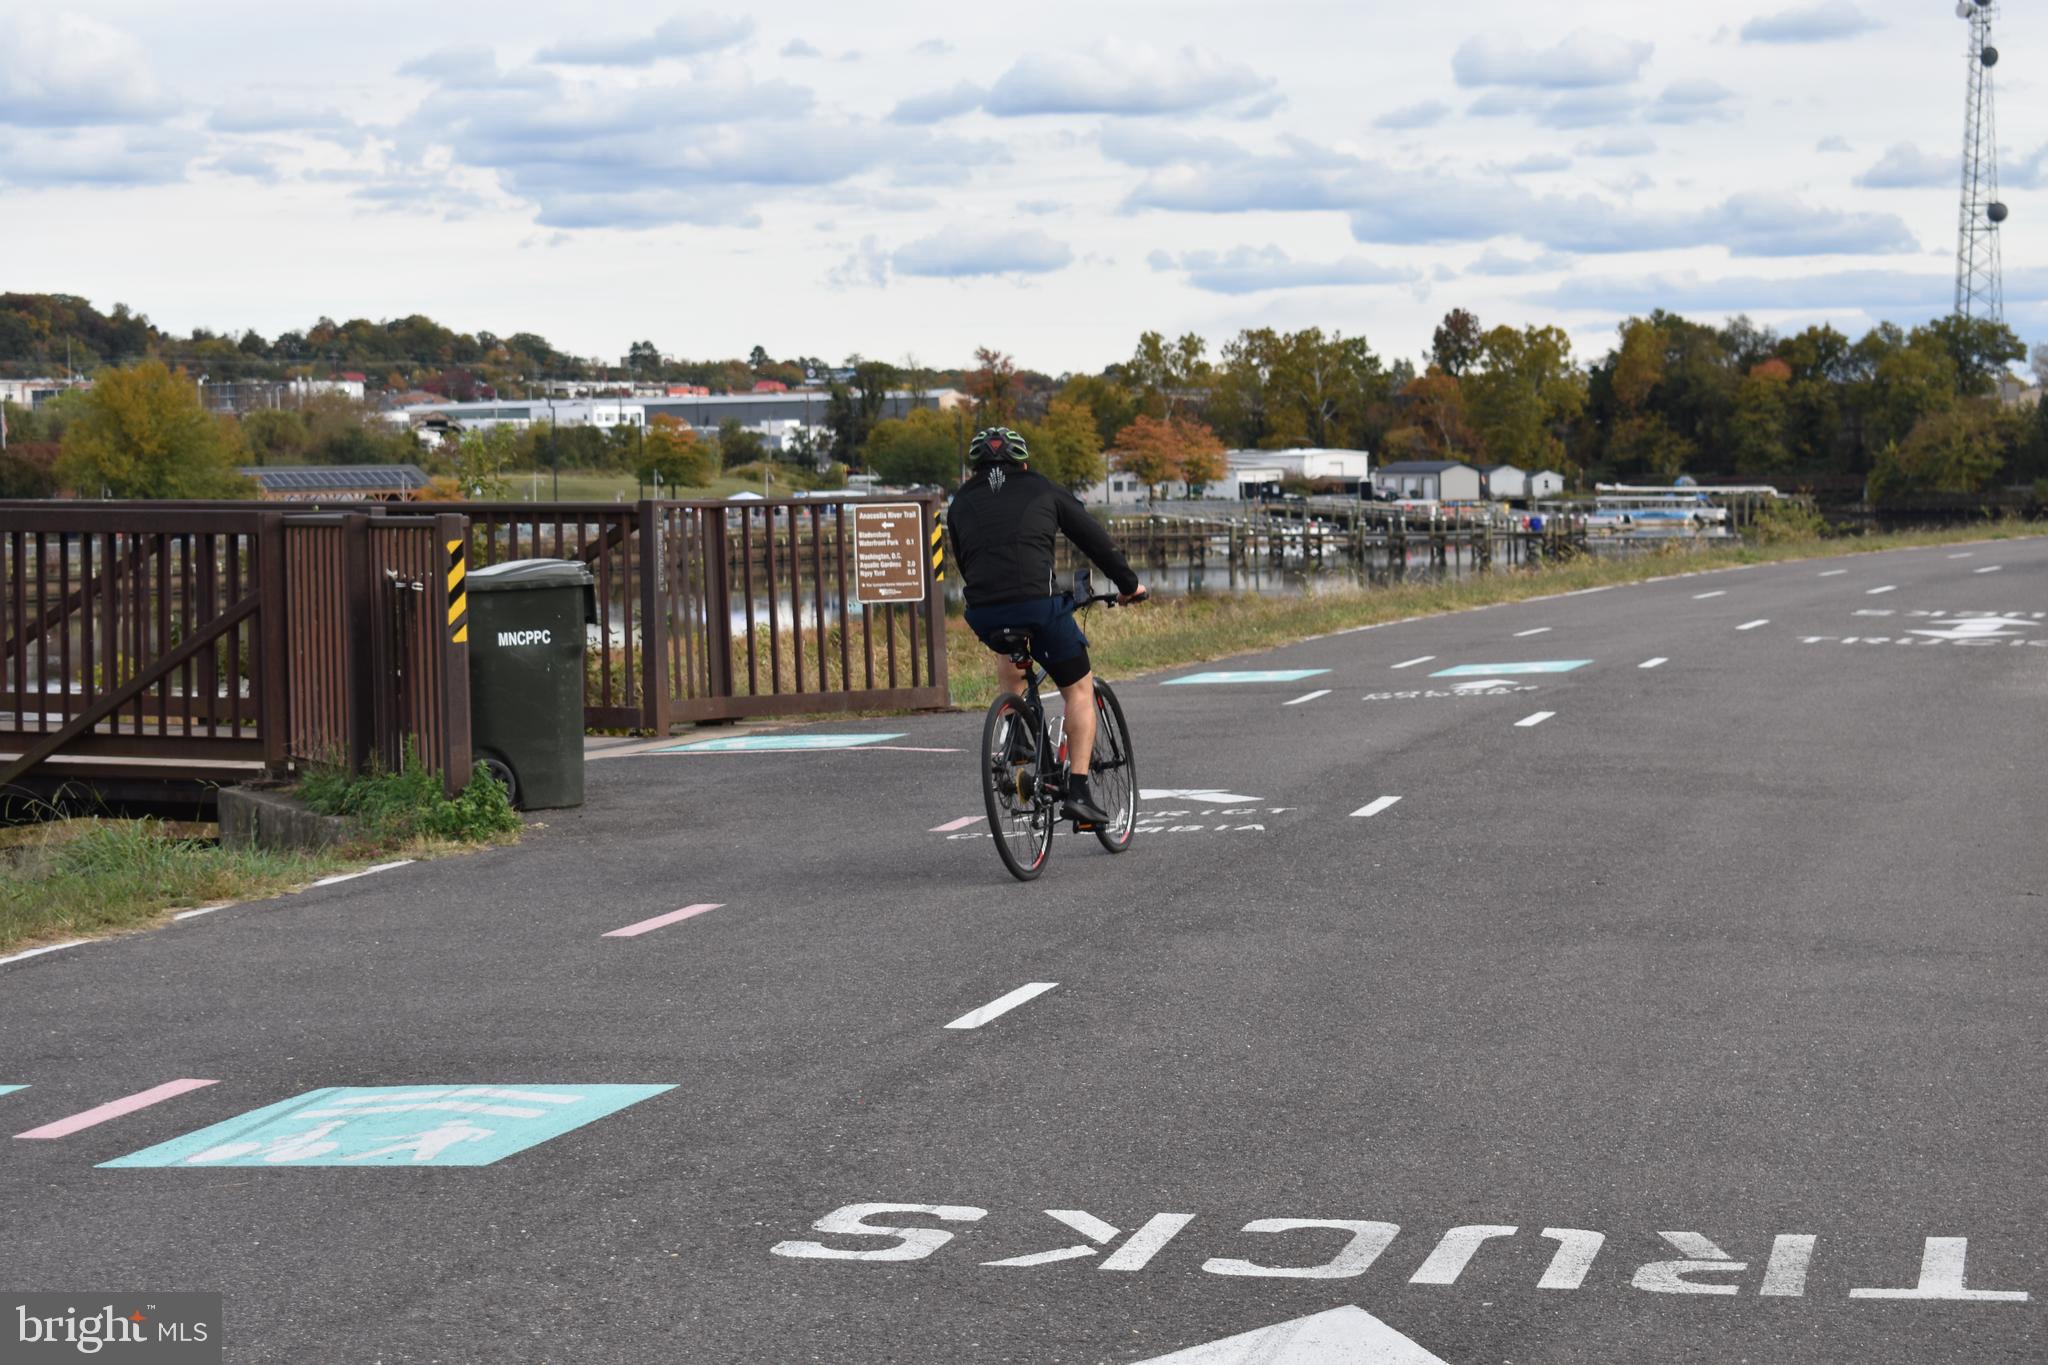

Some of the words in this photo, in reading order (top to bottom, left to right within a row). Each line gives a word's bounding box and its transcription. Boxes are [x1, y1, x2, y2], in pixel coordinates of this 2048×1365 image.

[887, 511, 902, 519] River
[858, 539, 886, 547] Waterfront
[498, 629, 551, 647] MNCPPC
[770, 1202, 2031, 1302] TRUCKS
